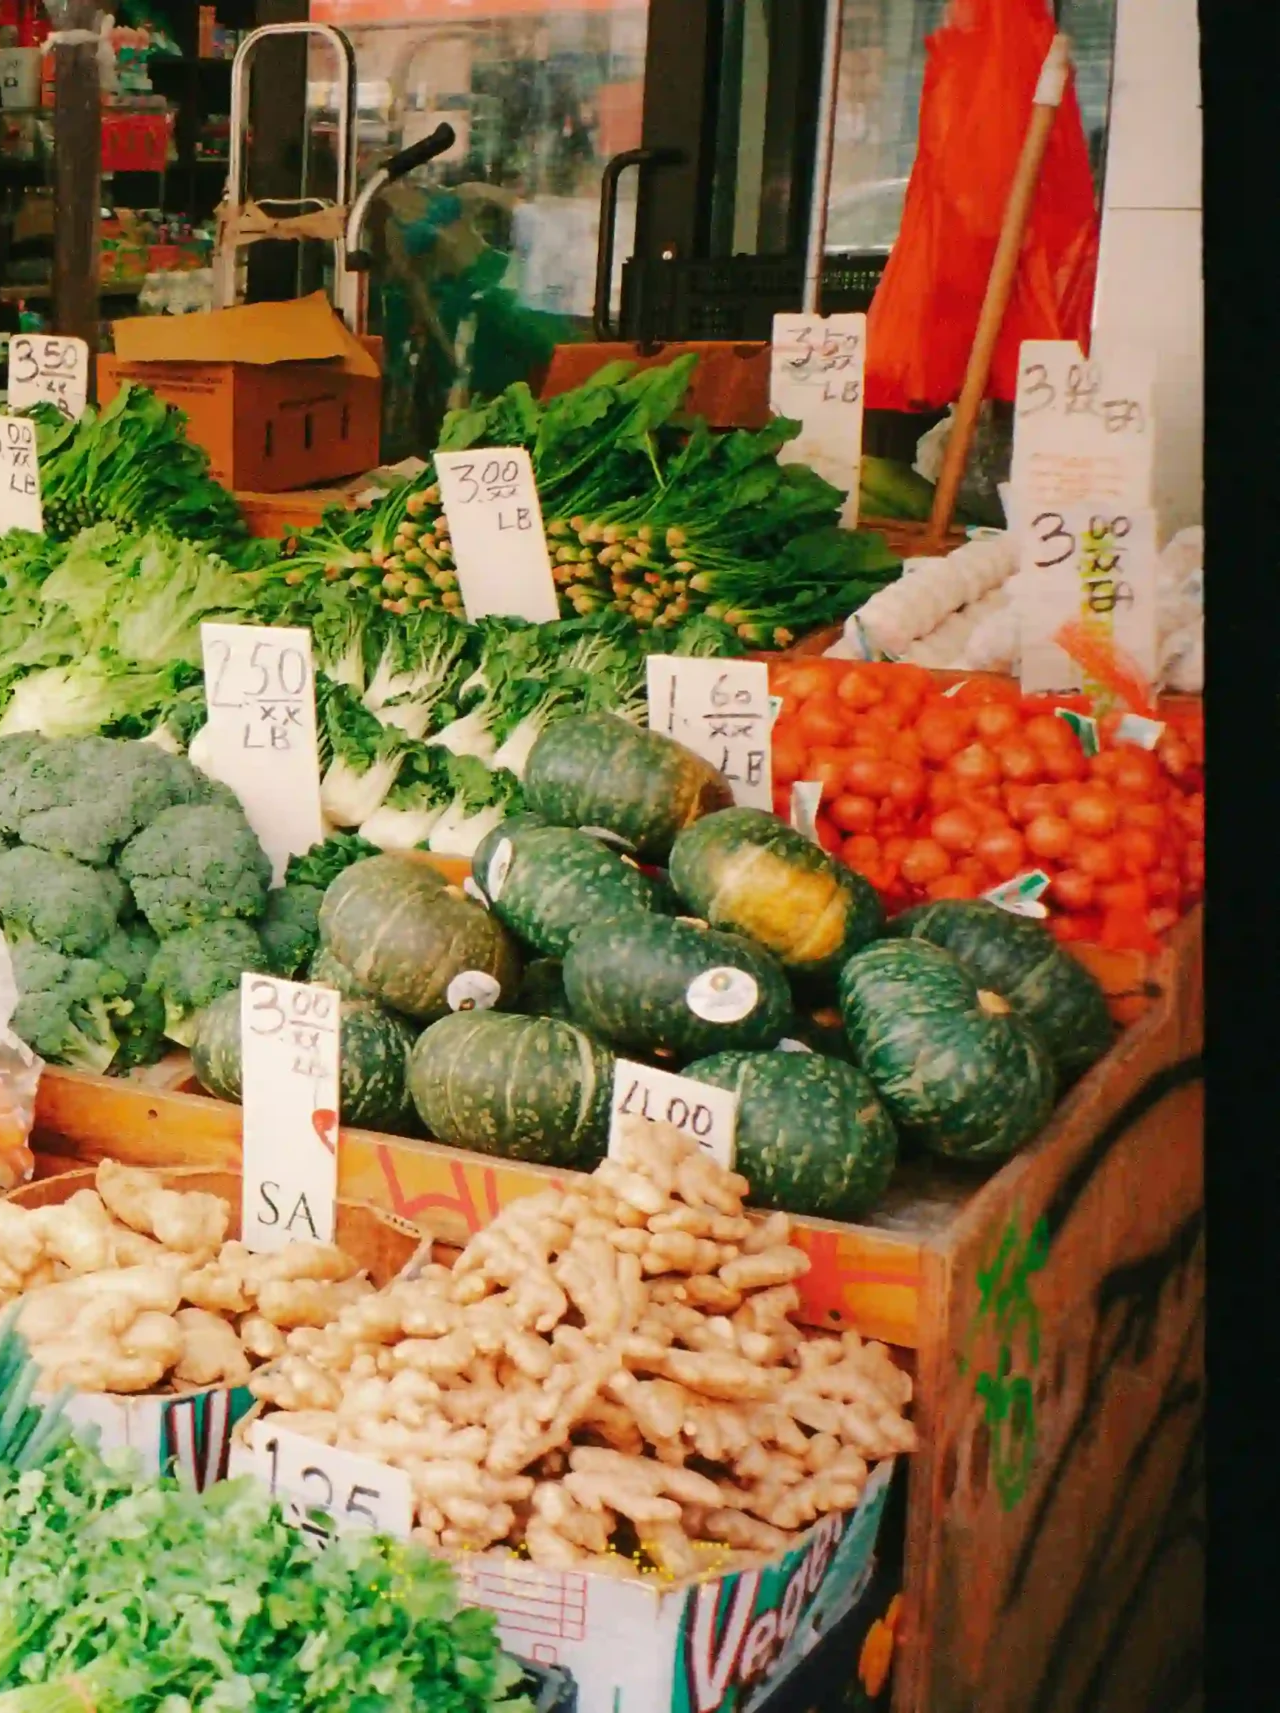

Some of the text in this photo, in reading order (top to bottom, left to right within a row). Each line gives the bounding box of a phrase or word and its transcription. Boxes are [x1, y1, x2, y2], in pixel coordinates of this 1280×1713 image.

[8, 473, 37, 495] LB
[497, 507, 533, 532] LB
[242, 722, 292, 751] LB
[720, 745, 765, 787] LB
[256, 1180, 321, 1241] SA
